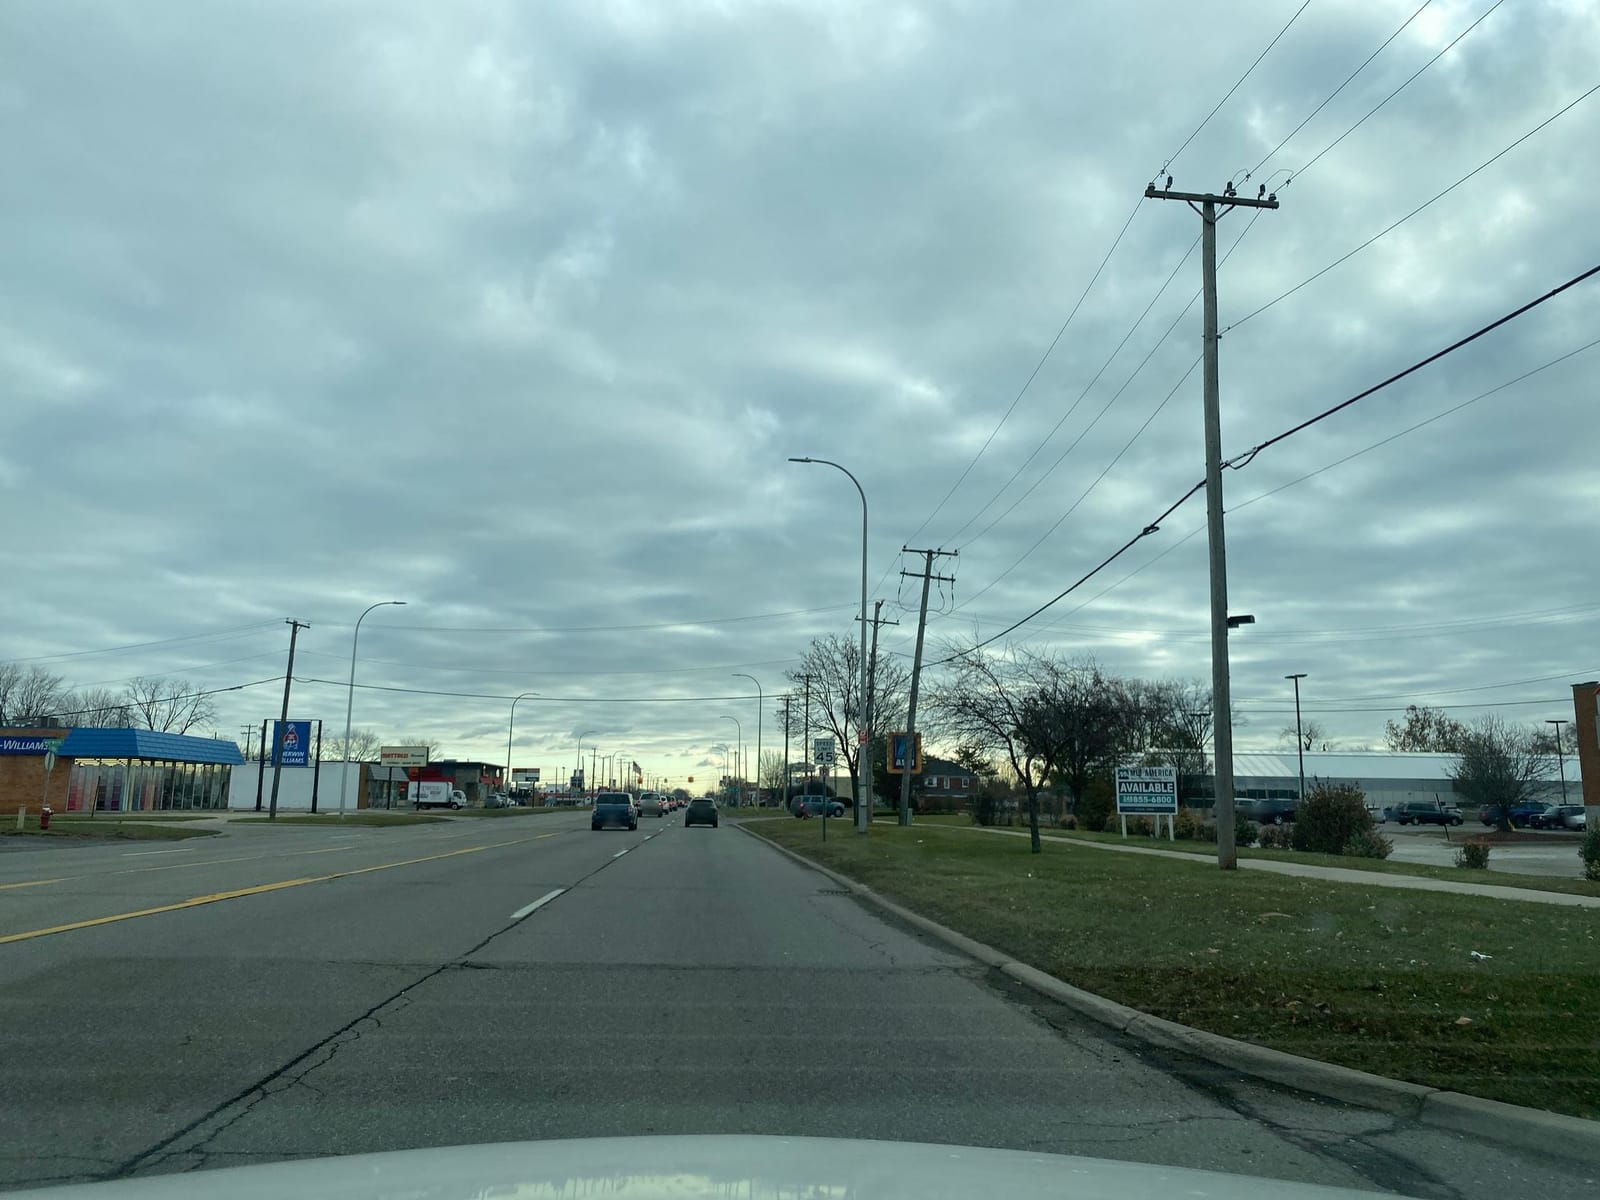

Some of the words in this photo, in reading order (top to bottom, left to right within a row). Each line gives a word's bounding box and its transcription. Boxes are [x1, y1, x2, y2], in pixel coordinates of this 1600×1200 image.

[816, 752, 833, 762] 45
[1144, 768, 1173, 777] AMERICA
[1120, 782, 1174, 793] AVAILABLE
